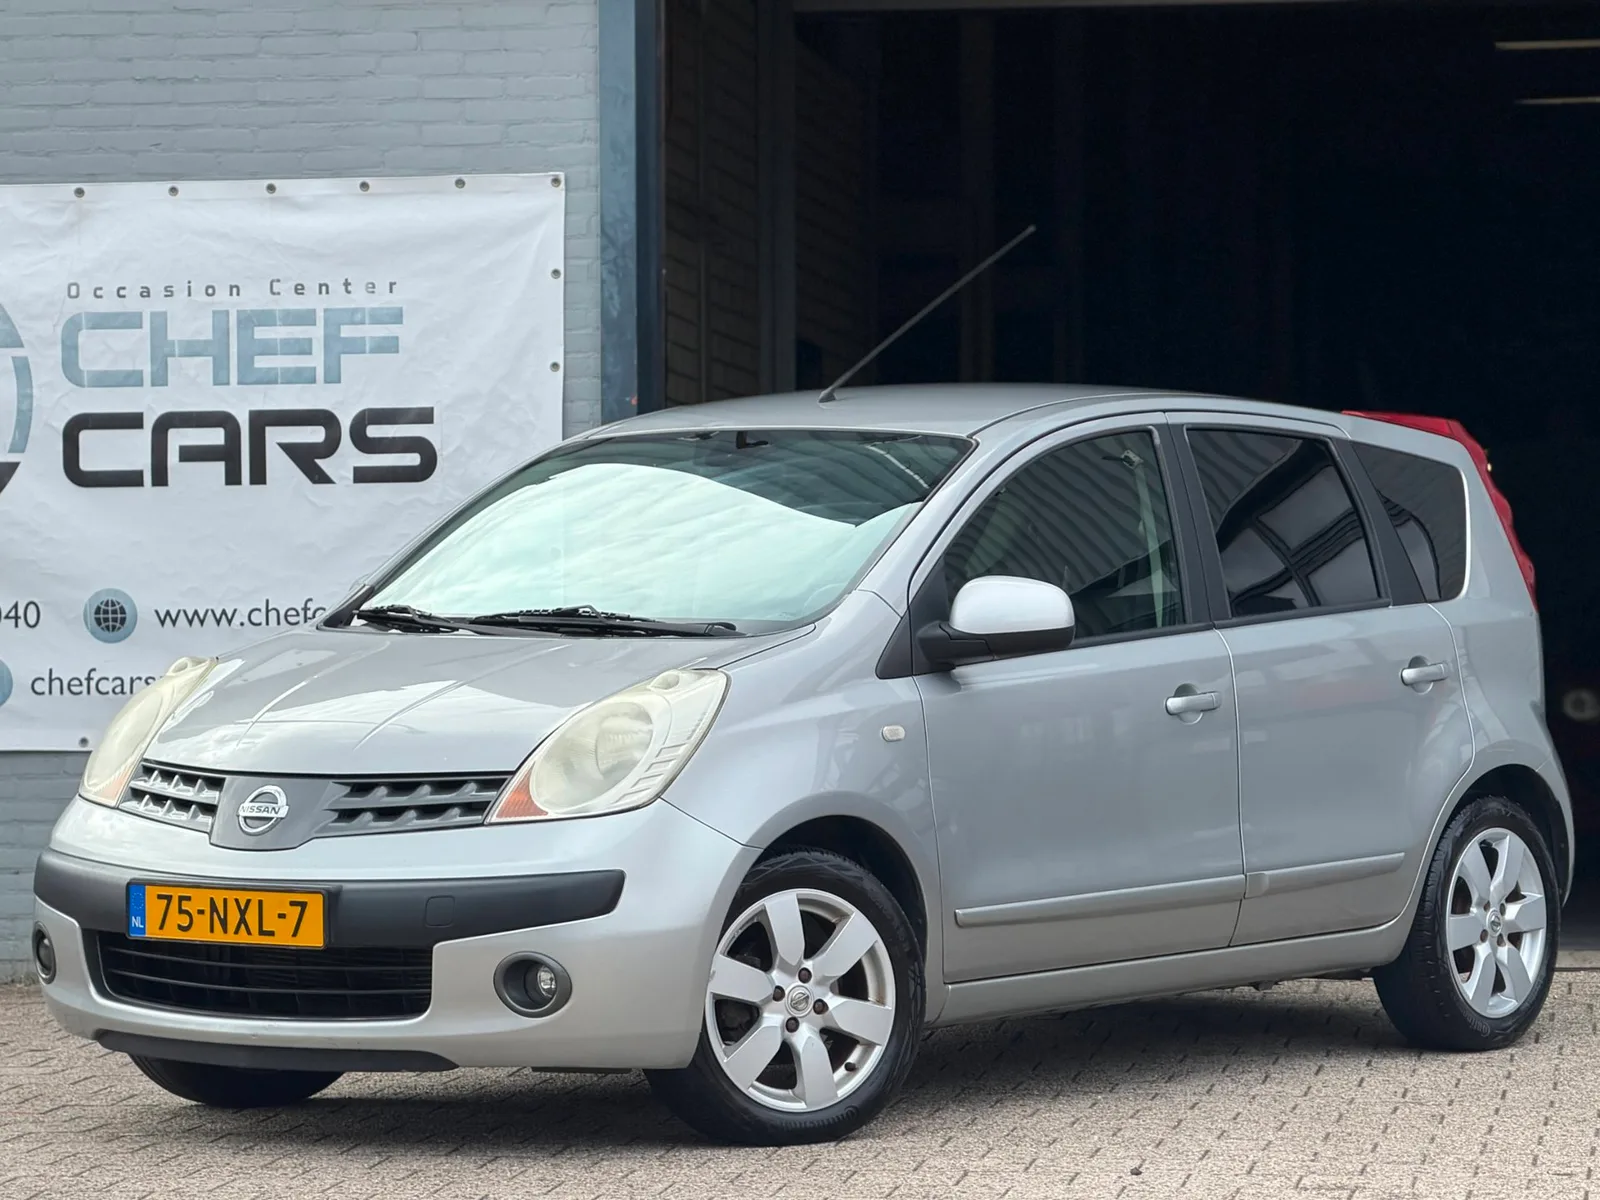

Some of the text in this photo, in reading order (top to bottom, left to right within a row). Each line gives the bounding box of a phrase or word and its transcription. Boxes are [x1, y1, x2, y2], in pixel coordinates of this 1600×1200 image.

[67, 277, 398, 299] Occasion Center
[61, 306, 404, 389] CHEF
[62, 406, 438, 488] CARS
[0, 600, 41, 629] 40
[240, 805, 281, 815] NISSAN
[131, 915, 144, 928] NL
[156, 893, 309, 938] 75-NXL-7
